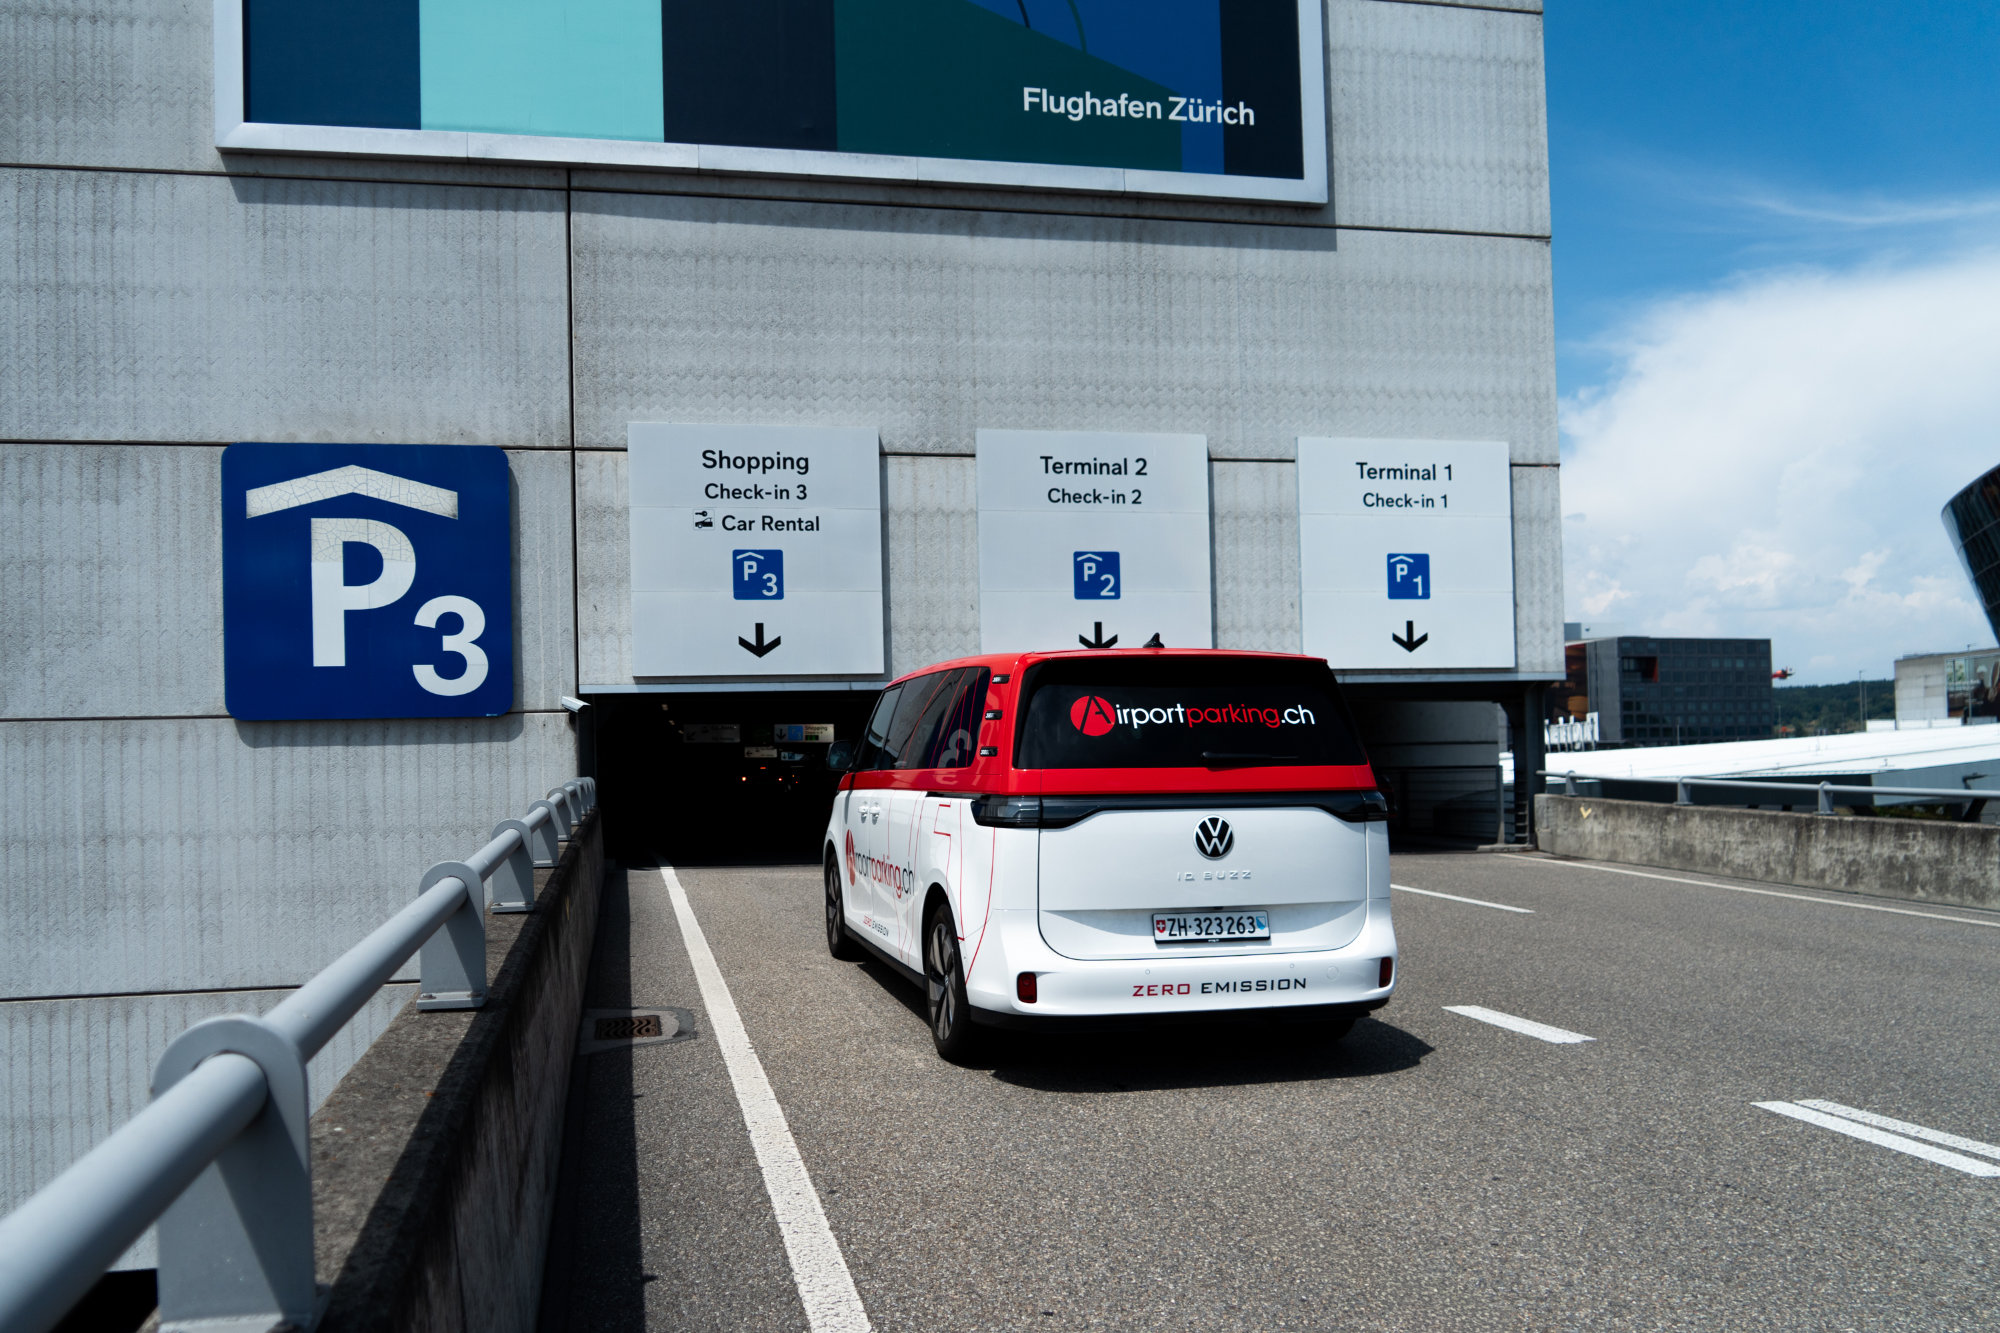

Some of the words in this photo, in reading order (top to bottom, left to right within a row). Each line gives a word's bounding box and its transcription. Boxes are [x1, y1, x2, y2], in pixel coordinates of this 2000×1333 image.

[1023, 87, 1162, 121] Flughafen
[1168, 96, 1255, 126] Zürich
[701, 449, 810, 475] Shopping
[1040, 456, 1128, 475] Terminal
[1135, 458, 1148, 476] 2
[1356, 462, 1436, 481] Terminal
[1444, 464, 1453, 481] 1
[704, 483, 790, 500] Check-in
[796, 484, 808, 500] 3
[1047, 488, 1126, 504] Check-in
[1131, 489, 1142, 504] 2
[1362, 493, 1435, 508] Check-in
[1441, 494, 1448, 508] 1
[721, 515, 756, 532] Car
[761, 515, 820, 532] Rental
[1070, 695, 1316, 737] Airportparking.ch
[1203, 870, 1252, 881] BUZZ
[1133, 983, 1191, 997] ZERO
[1201, 977, 1307, 994] EMISSION
